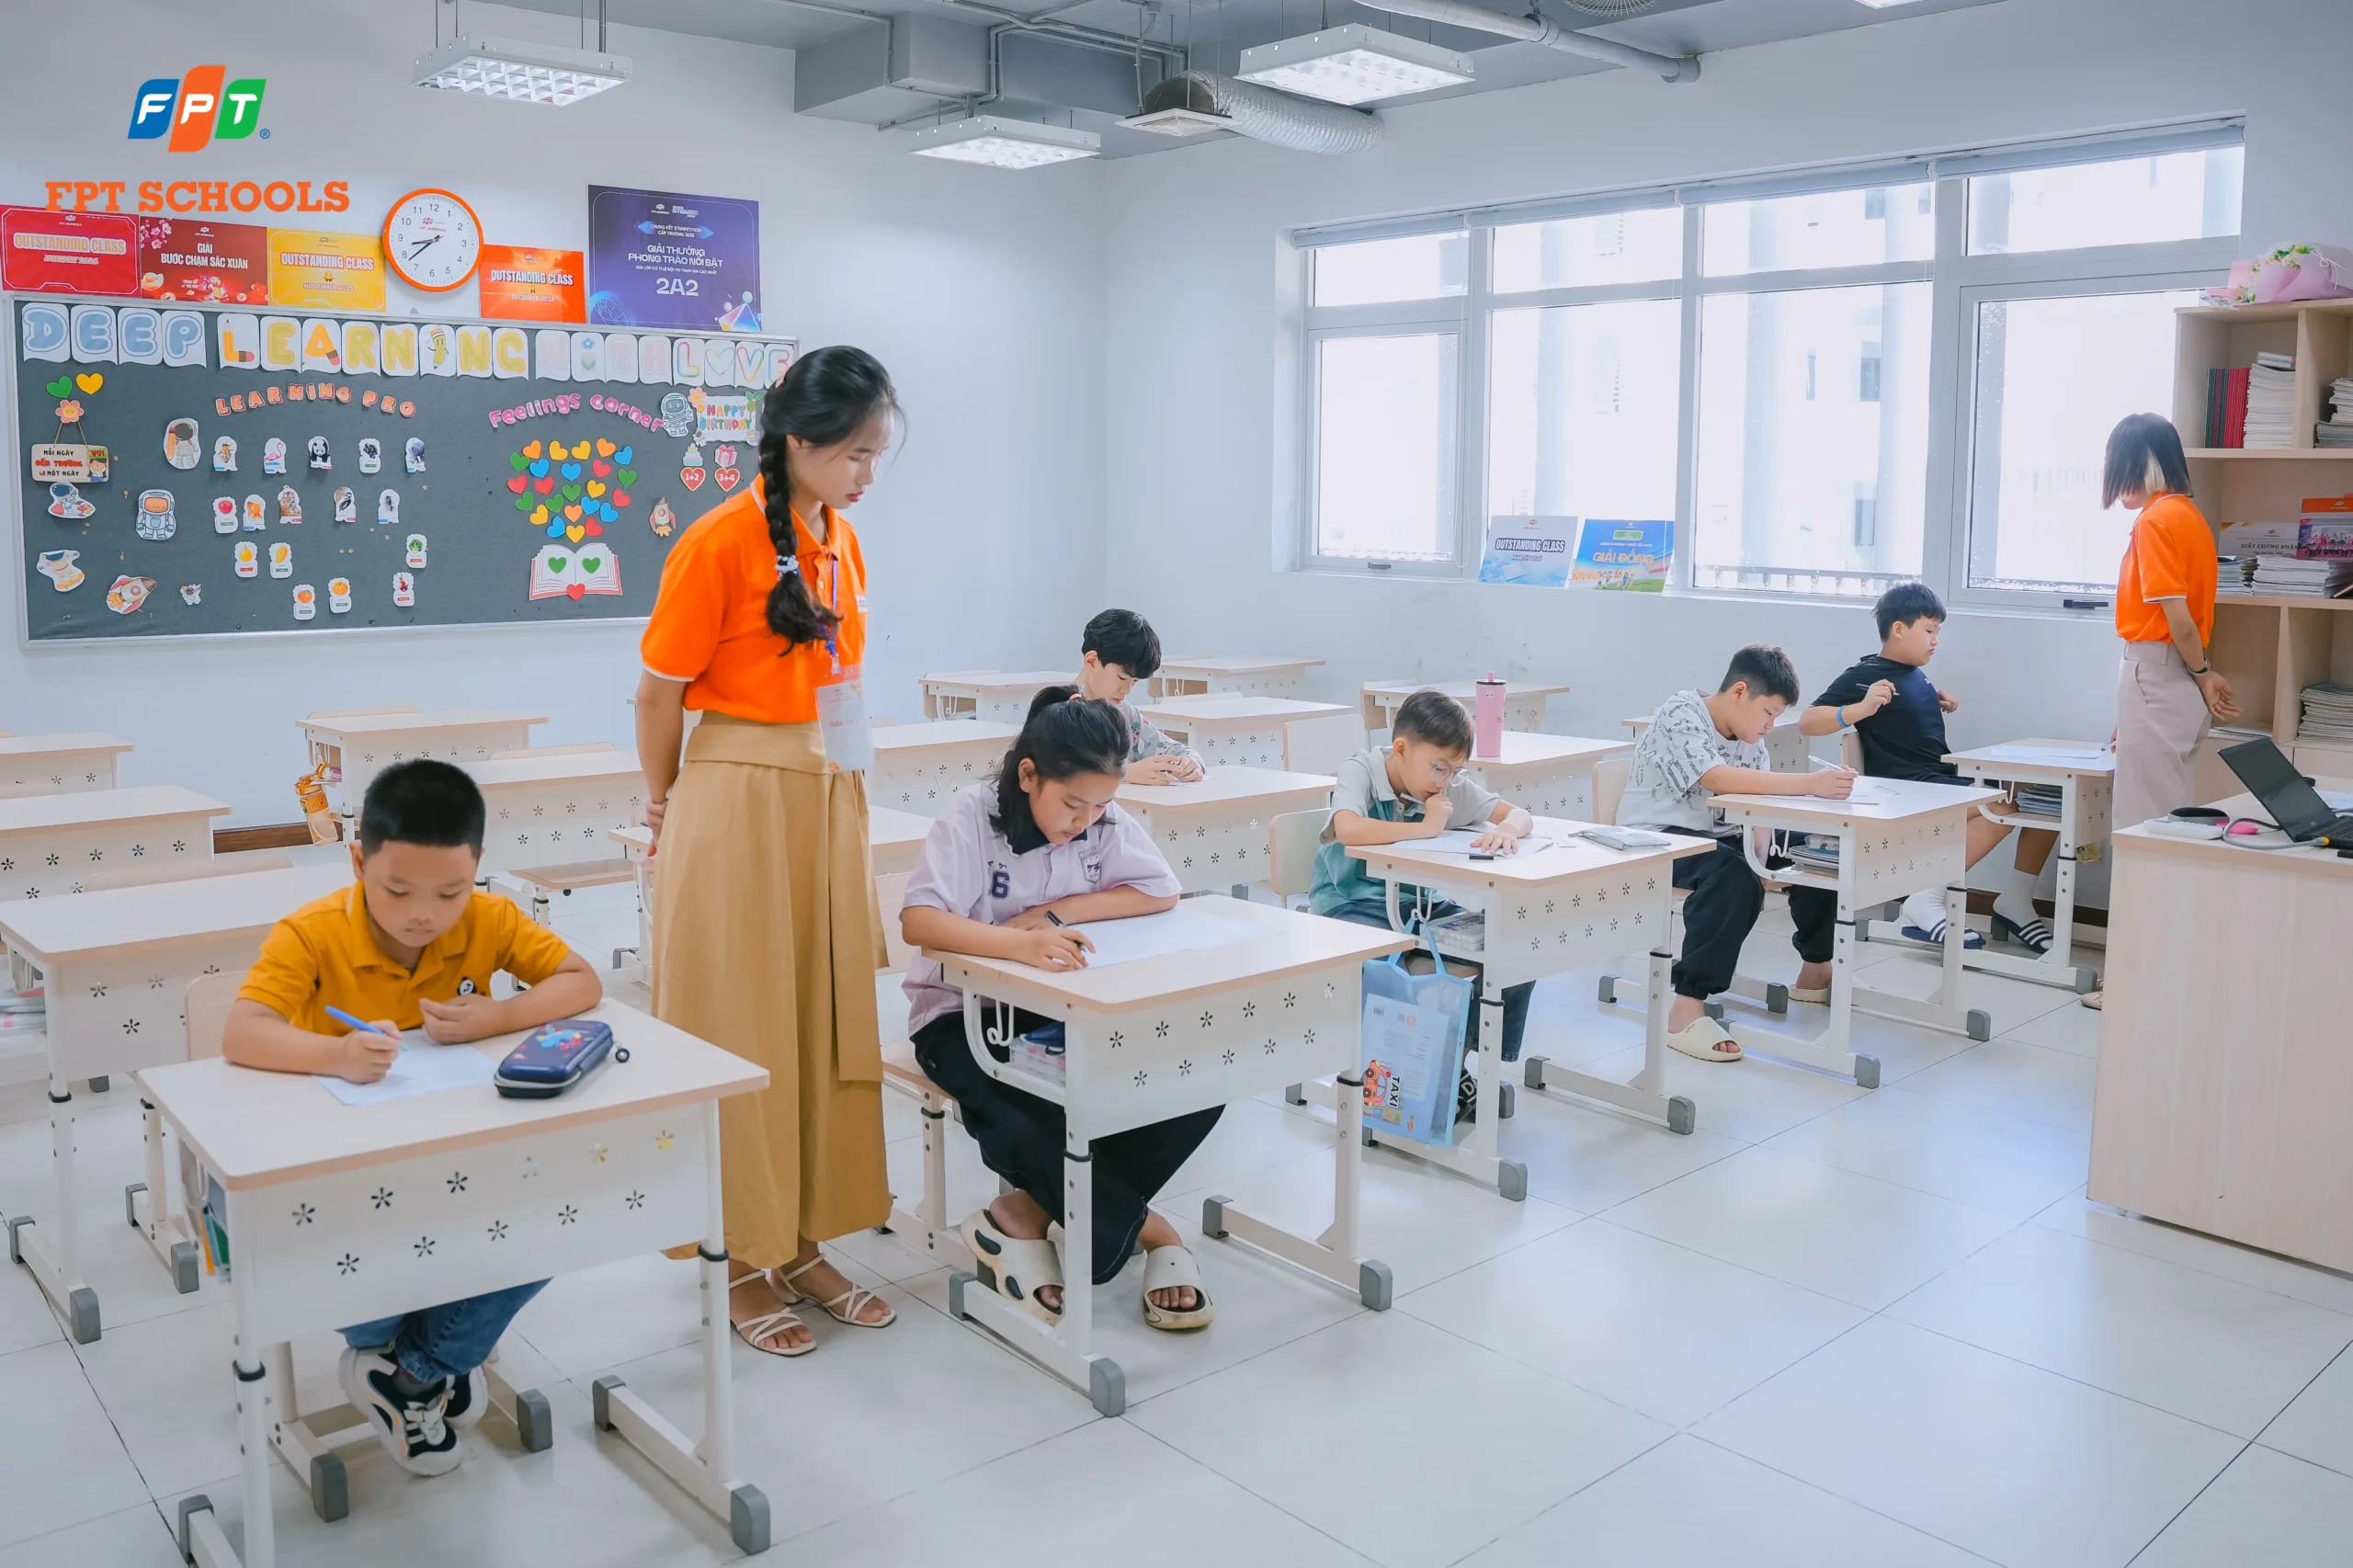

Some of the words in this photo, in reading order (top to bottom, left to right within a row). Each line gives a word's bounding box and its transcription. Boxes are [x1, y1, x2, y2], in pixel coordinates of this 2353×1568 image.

[413, 206, 422, 214] 11
[429, 203, 439, 211] 12
[457, 222, 463, 231] 2
[15, 233, 90, 253] OUTSTANDING
[91, 238, 126, 255] CLASS
[461, 239, 467, 247] 3
[647, 243, 665, 254] GIẢI
[665, 244, 706, 256] THƯỞNG
[43, 255, 78, 264] JANUARY
[78, 256, 98, 265] 2026
[186, 255, 208, 267] CHẠM
[280, 253, 344, 268] OUTSTANDING
[346, 256, 374, 270] CLASS
[628, 253, 662, 263] PHONG
[662, 254, 688, 265] TRÀO
[705, 257, 723, 269] BẬT
[491, 269, 546, 284] OUTSTANDING
[548, 273, 574, 286] CLASS
[655, 278, 699, 297] 2A2
[23, 307, 203, 359] DEEP
[216, 383, 352, 415] LEARNING
[362, 390, 415, 418] PRO
[488, 392, 582, 428] Feelings
[707, 403, 746, 417] HAPPY
[699, 417, 753, 431] BIRTHDAY
[43, 448, 55, 456] MỖI
[56, 449, 74, 457] NGÀY
[685, 472, 699, 482] 1+2
[719, 472, 735, 483] 3+4
[1495, 539, 1541, 551] OUTSTANDING
[1542, 540, 1565, 552] CLASS
[992, 871, 1010, 899] 6
[1389, 1076, 1401, 1108] TAXI
